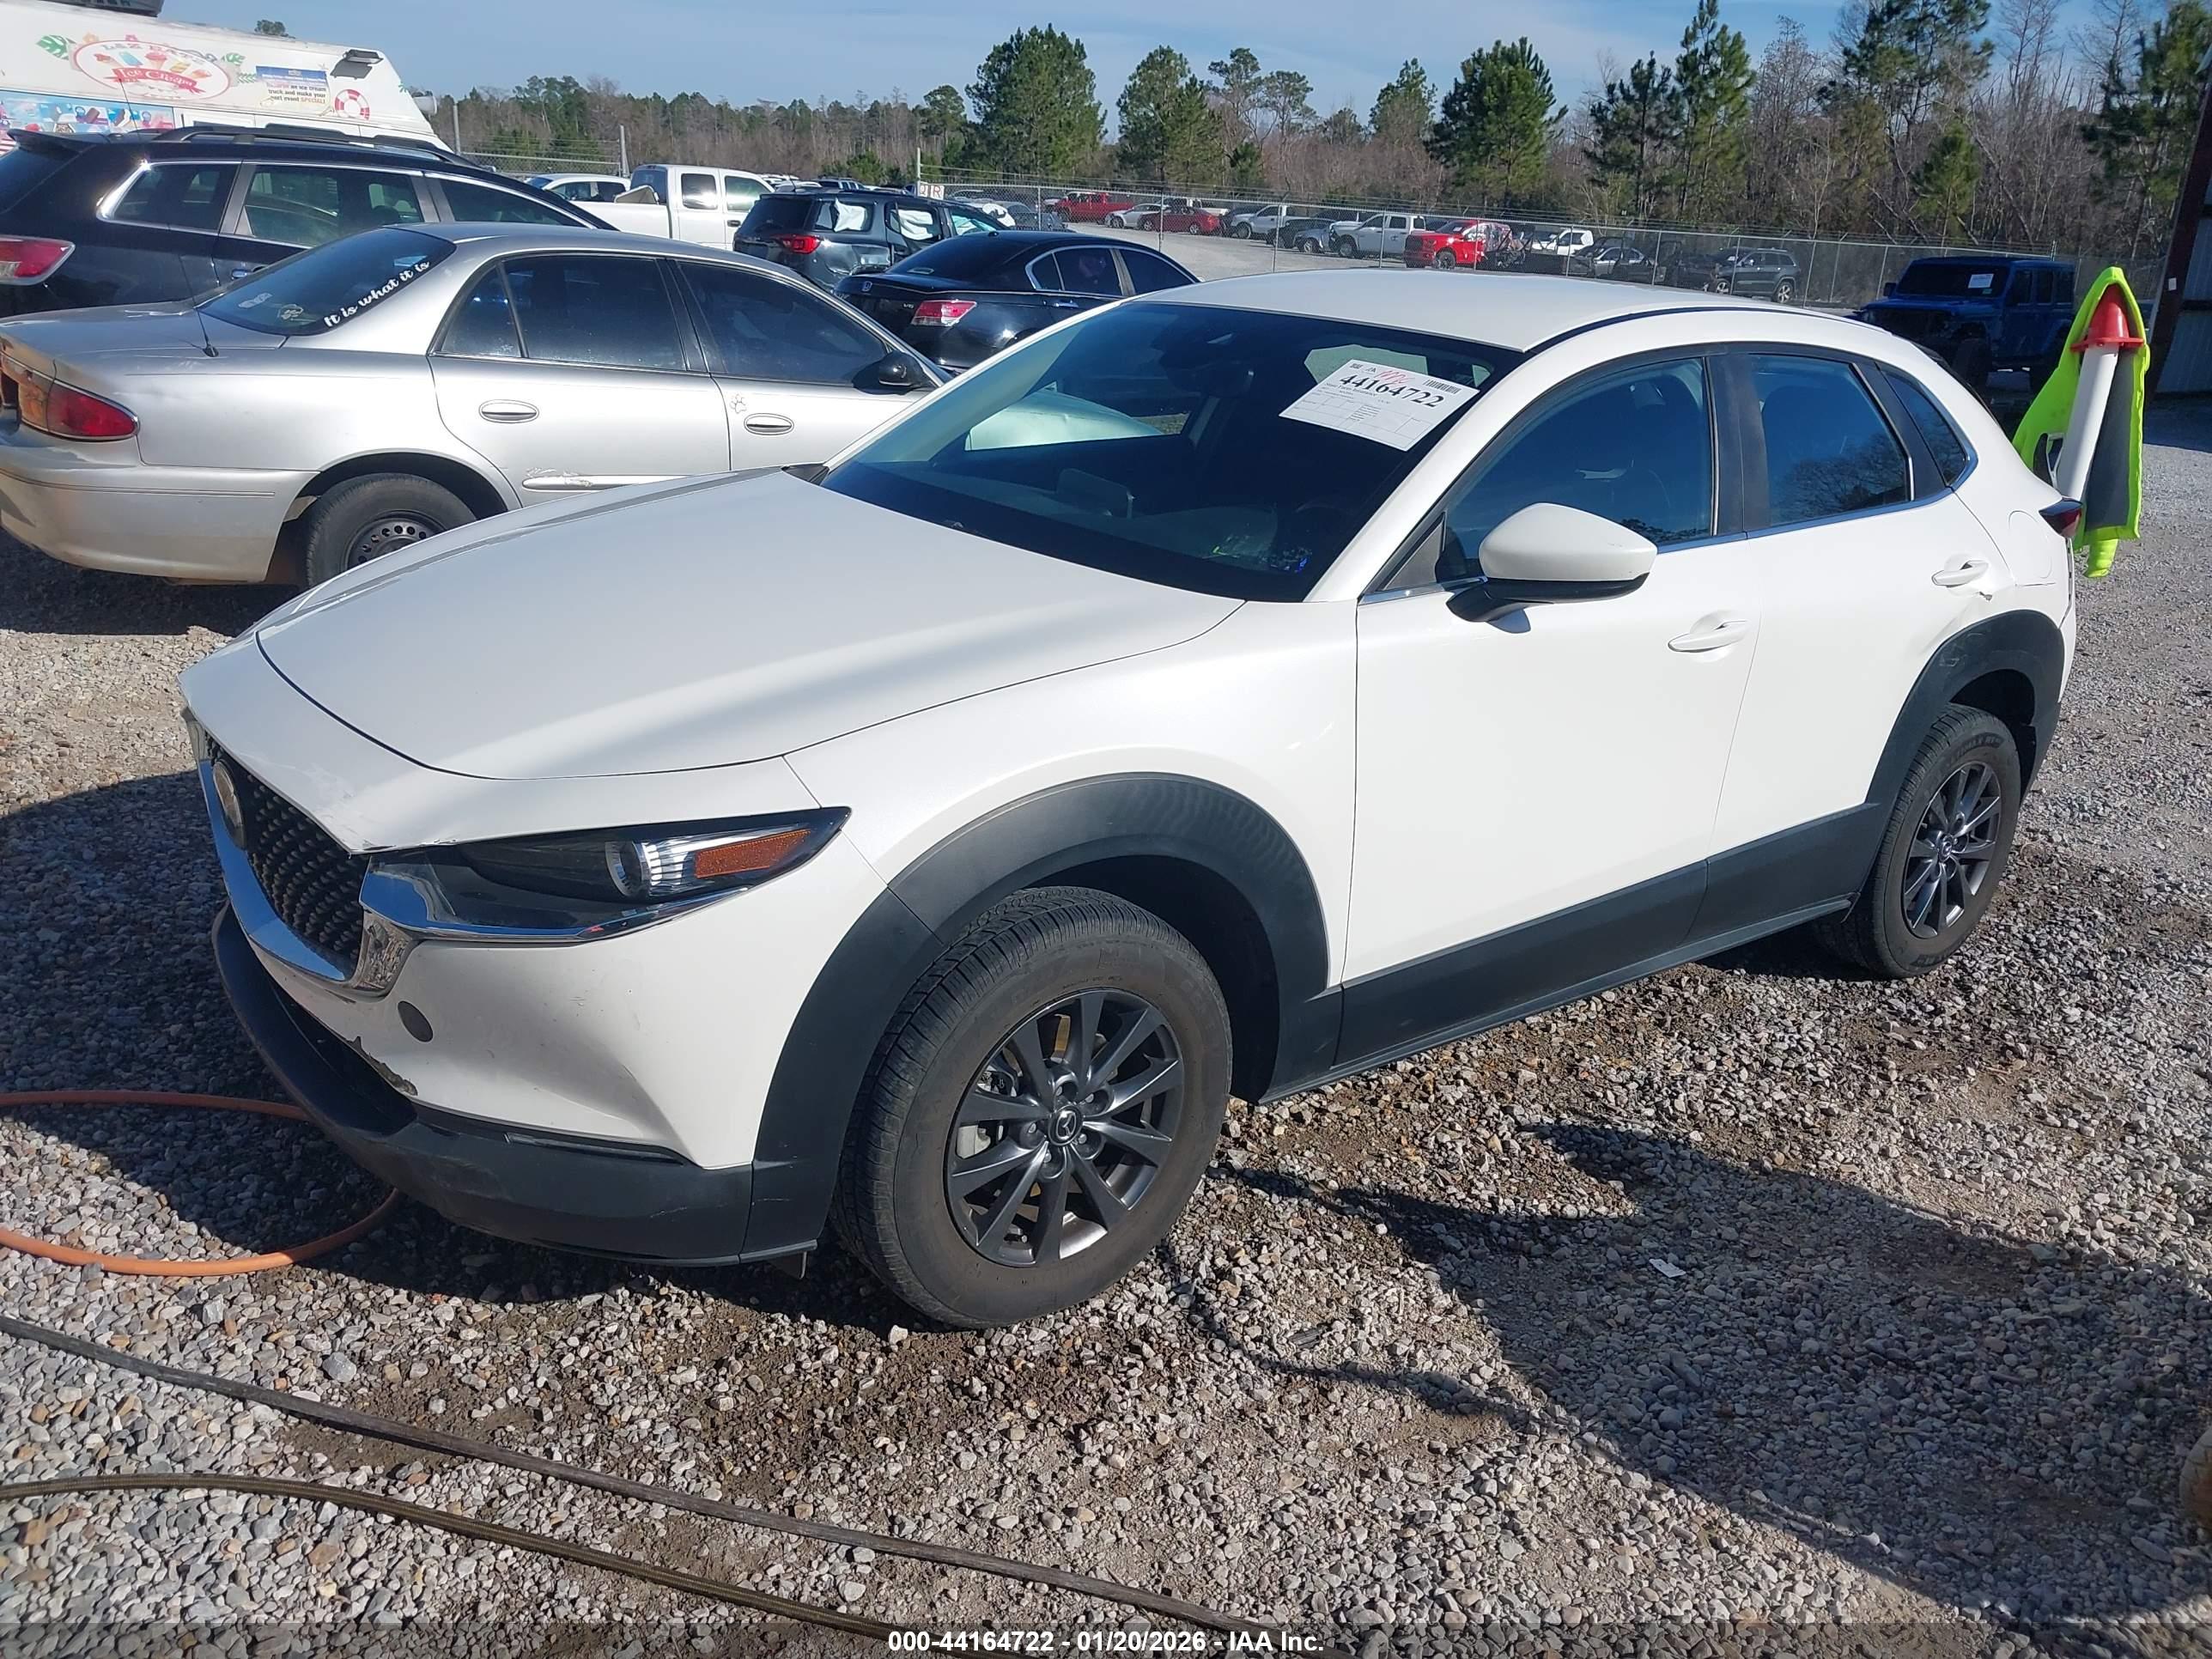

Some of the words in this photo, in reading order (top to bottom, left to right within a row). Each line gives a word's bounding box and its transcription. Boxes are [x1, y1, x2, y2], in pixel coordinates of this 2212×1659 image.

[121, 68, 143, 79] Ice
[933, 185, 941, 198] R
[324, 314, 341, 327] It
[342, 307, 358, 318] is
[358, 277, 399, 307] what
[399, 270, 414, 282] it
[415, 261, 429, 272] is
[1340, 374, 1445, 408] 44164722
